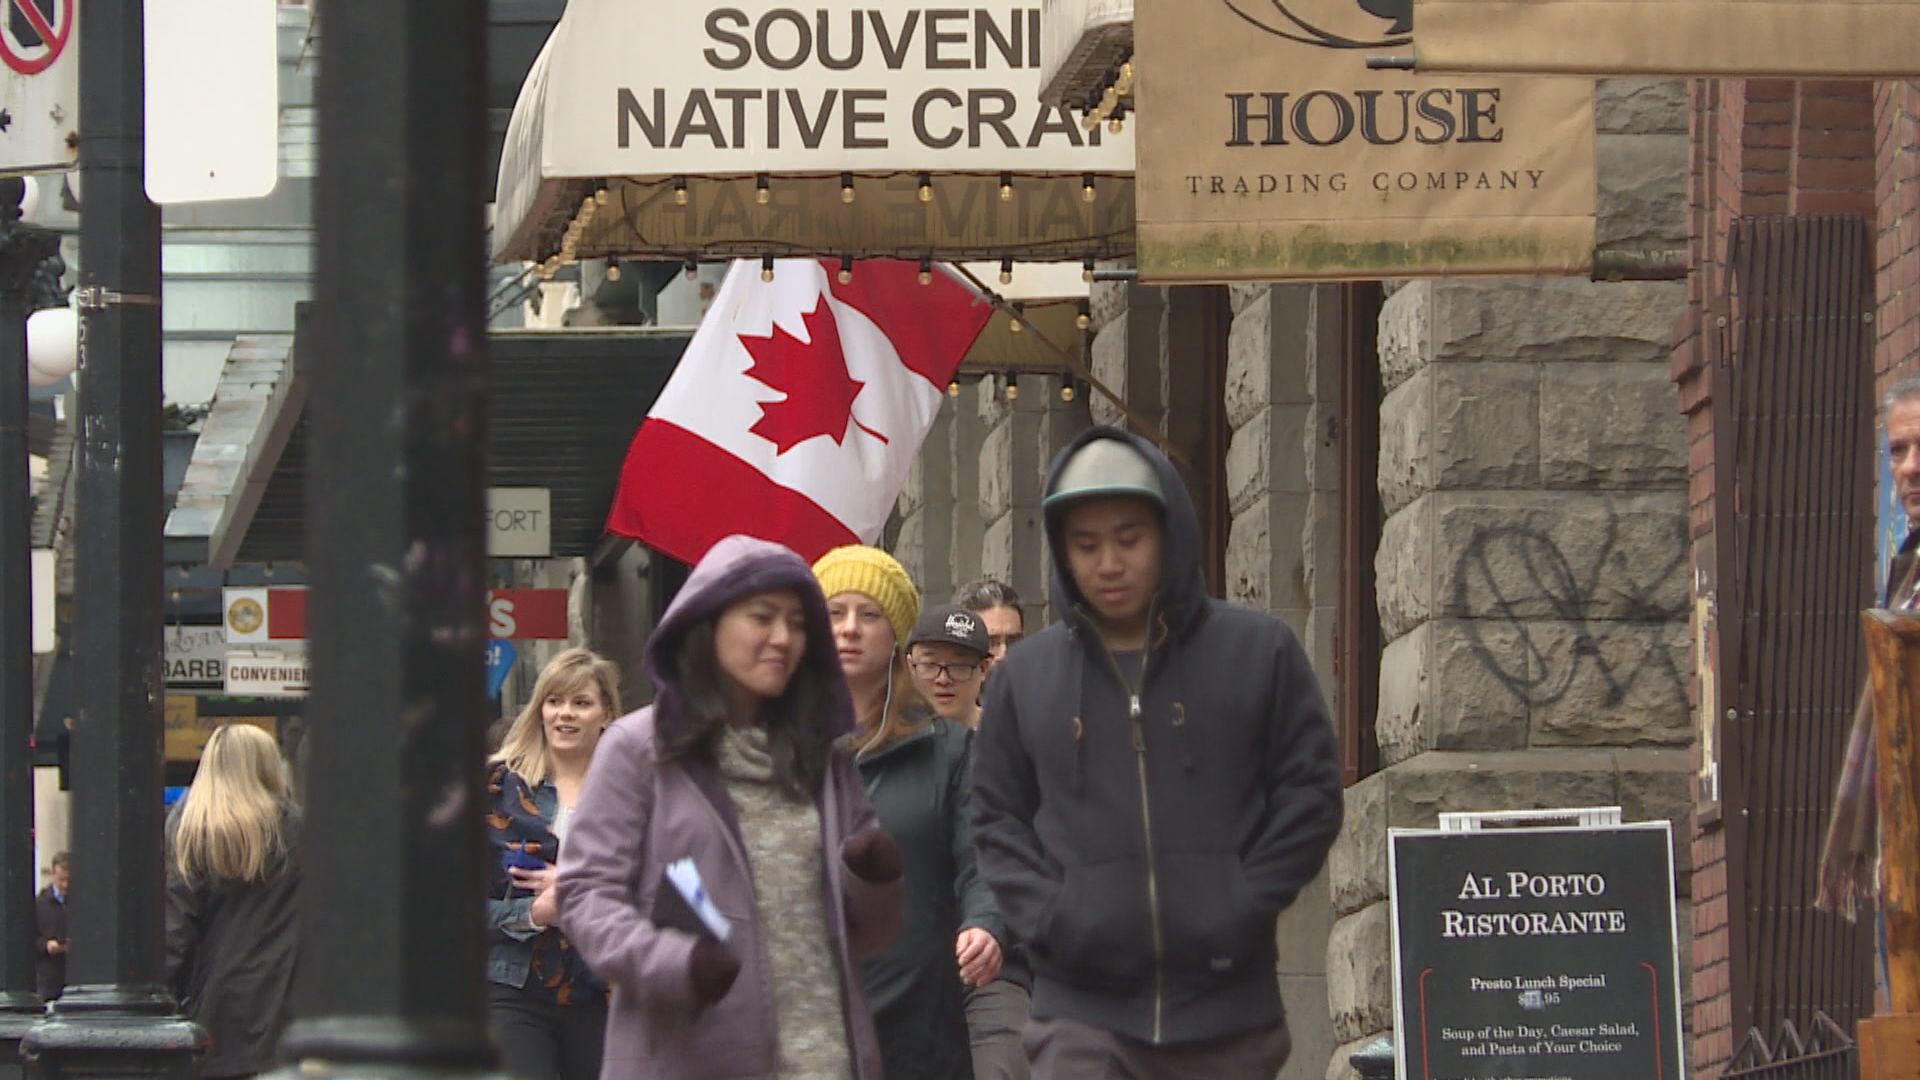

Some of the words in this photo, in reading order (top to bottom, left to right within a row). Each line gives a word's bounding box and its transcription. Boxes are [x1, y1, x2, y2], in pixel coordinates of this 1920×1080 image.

[702, 8, 1040, 70] SOUVENI
[617, 88, 888, 149] NATIVE
[1225, 88, 1504, 147] HOUSE
[1186, 174, 1347, 194] TRADING
[1372, 169, 1545, 192] COMPANY
[1457, 872, 1501, 899] AL
[1507, 871, 1605, 898] PORTO
[1441, 910, 1626, 938] RISTORANTE
[1471, 977, 1512, 990] Presto
[1515, 976, 1556, 989] Lunch
[1559, 974, 1606, 990] Special
[1442, 1028, 1474, 1041] Soup
[1478, 1027, 1491, 1039] of
[1493, 1026, 1514, 1039] the
[1551, 1023, 1596, 1037] Caesar
[1461, 1043, 1485, 1056] and
[1489, 1043, 1526, 1056] Pasta
[1529, 1042, 1541, 1054] of
[1544, 1041, 1576, 1054] Your
[1579, 1040, 1622, 1053] Choice
